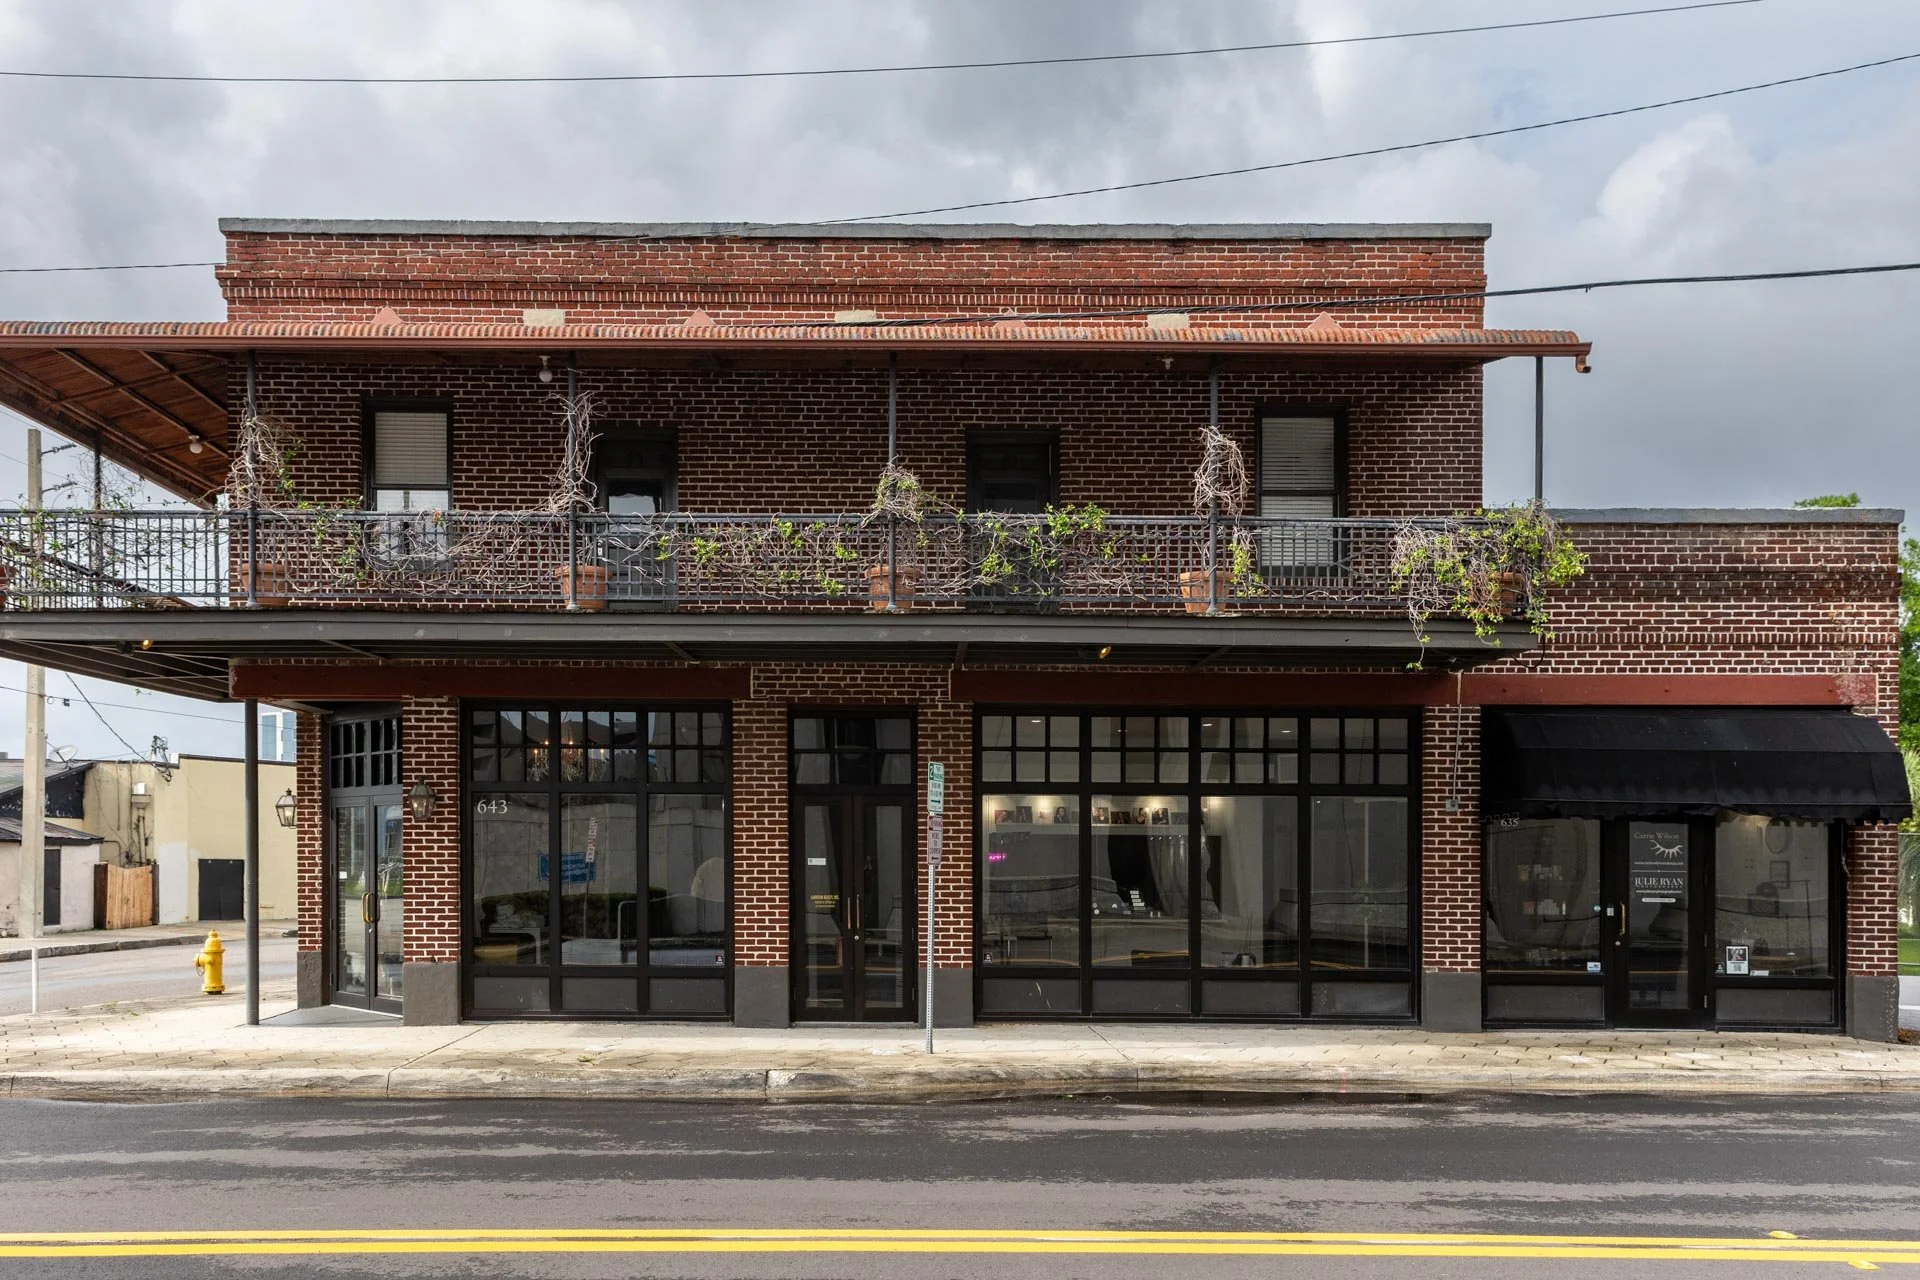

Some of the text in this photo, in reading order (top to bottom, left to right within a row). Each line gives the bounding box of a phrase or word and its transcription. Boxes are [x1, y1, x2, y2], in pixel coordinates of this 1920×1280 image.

[477, 799, 508, 814] 643
[1500, 817, 1519, 827] 635
[1656, 832, 1680, 840] Wilson
[1635, 877, 1684, 886] JULIE RYAN
